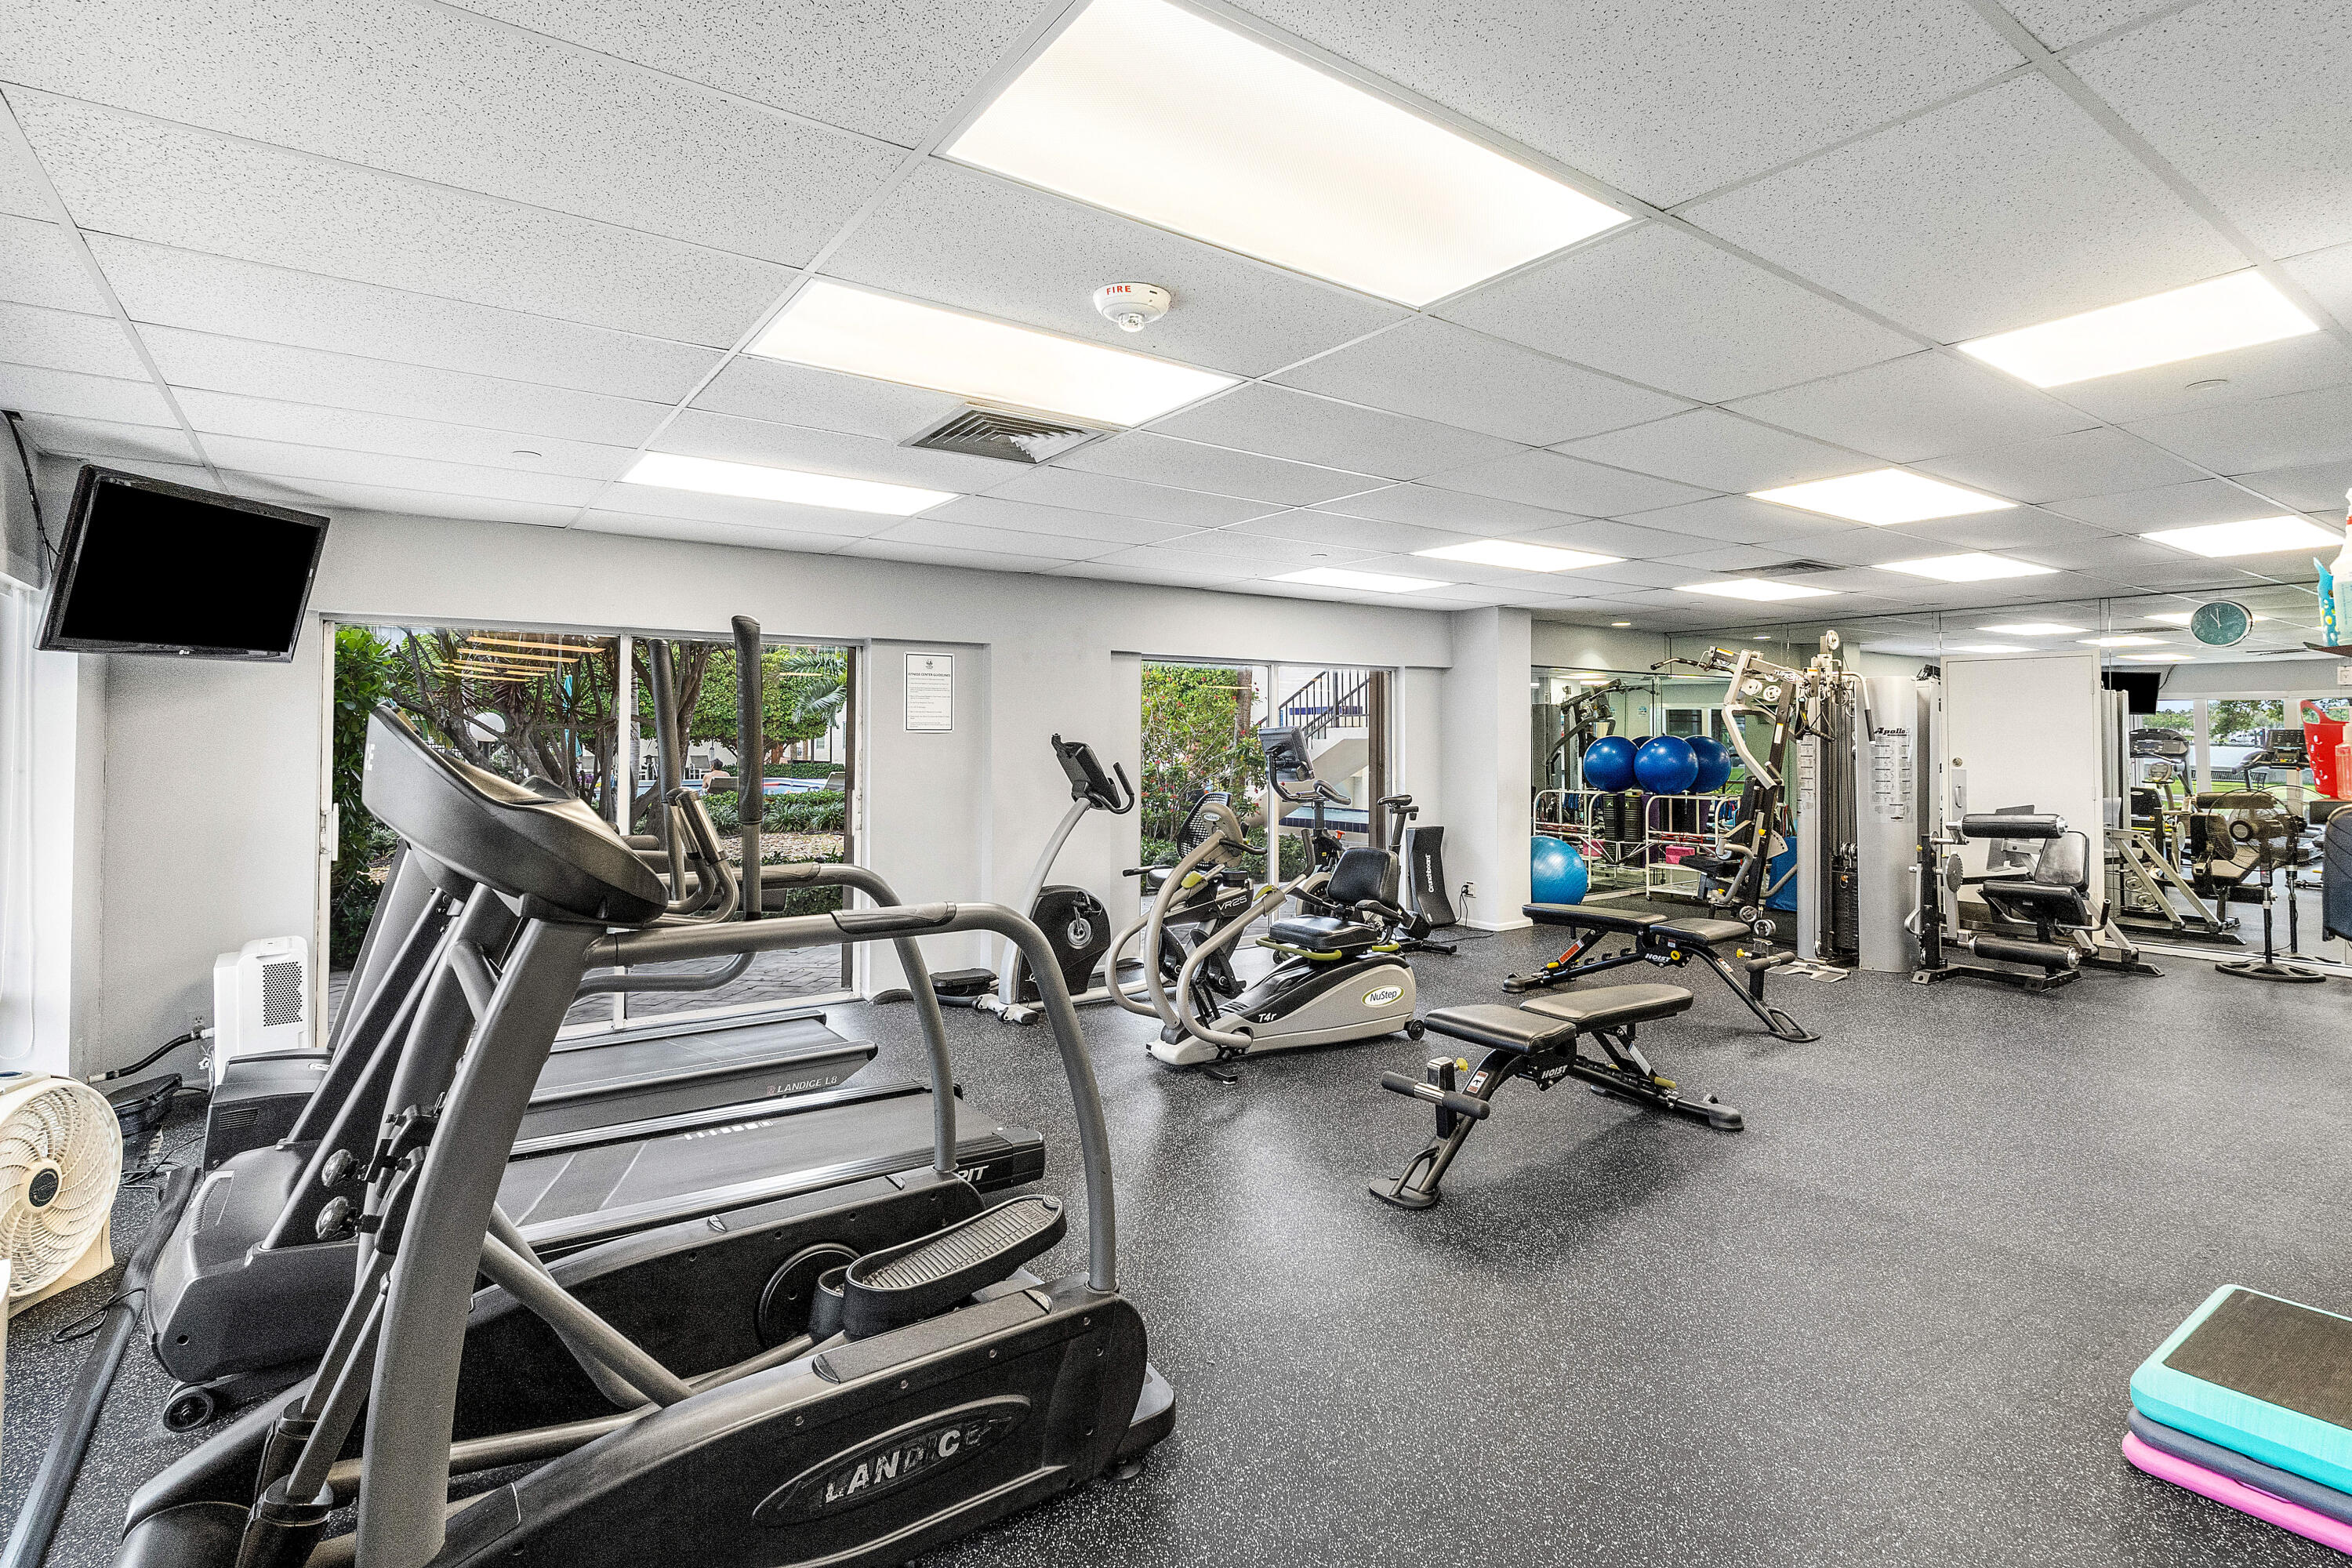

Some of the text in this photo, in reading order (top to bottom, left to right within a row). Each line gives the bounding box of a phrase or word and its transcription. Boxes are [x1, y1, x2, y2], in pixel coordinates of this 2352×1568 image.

[1106, 285, 1131, 296] FIRE
[1874, 727, 1906, 735] Apollo
[1425, 854, 1434, 893] Crunchboard
[1218, 895, 1247, 910] VR25
[1645, 953, 1671, 962] HOIST
[1370, 992, 1397, 1001] NuStep
[1258, 1012, 1277, 1023] T4r
[1541, 1065, 1568, 1080] HOIST
[777, 1076, 837, 1093] LANDICE L8
[825, 1424, 984, 1504] LANDICE
